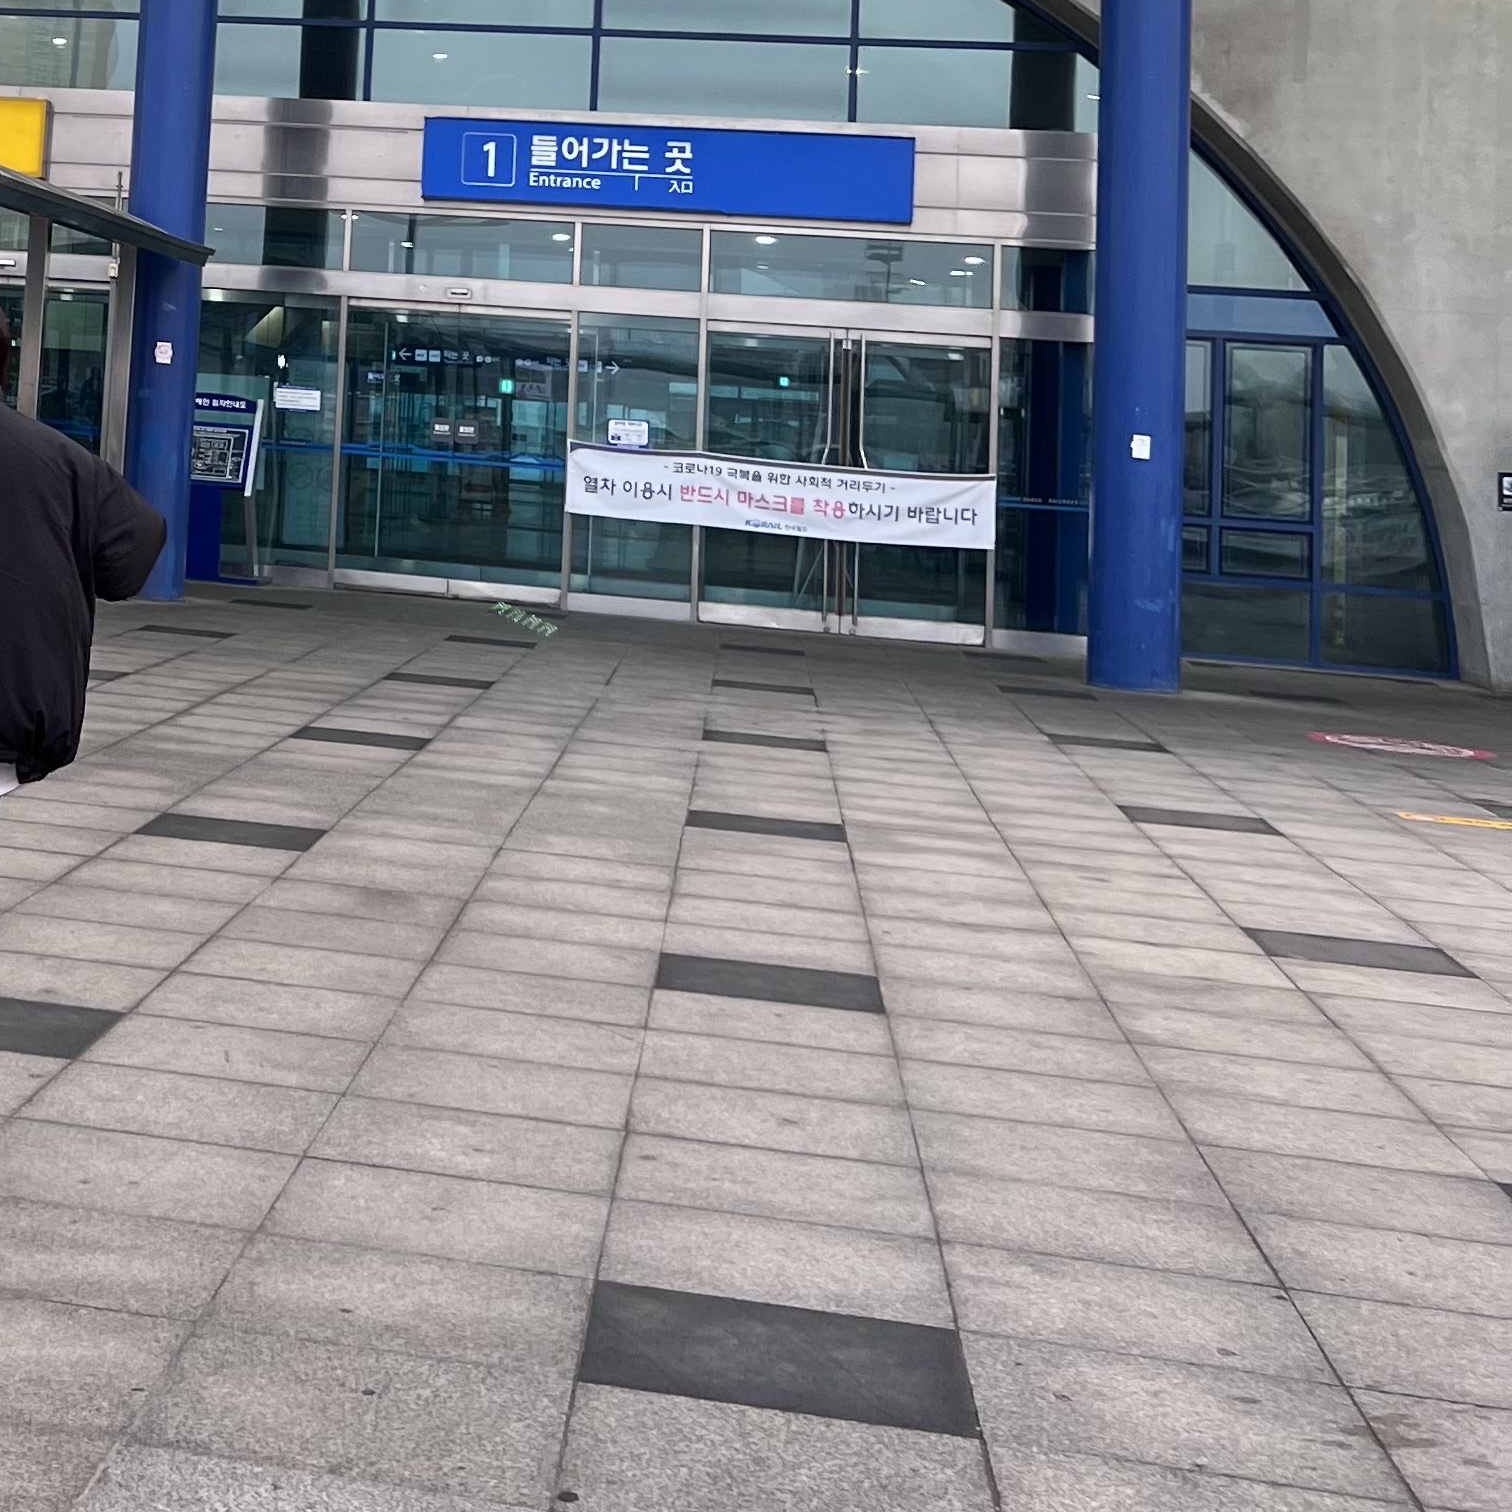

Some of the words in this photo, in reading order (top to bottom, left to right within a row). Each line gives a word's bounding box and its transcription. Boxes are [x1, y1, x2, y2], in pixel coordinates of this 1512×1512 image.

[482, 141, 496, 177] 1
[531, 135, 650, 171] 들어가는
[664, 140, 693, 174] 곳
[529, 172, 601, 190] Entrance
[668, 180, 693, 194] 入口
[672, 462, 723, 476] 코로나19
[727, 468, 763, 483] 극복을
[767, 472, 791, 486] 위한
[795, 475, 833, 489] 사회적
[836, 478, 886, 494] 거리두기
[583, 475, 616, 496] 열차
[623, 480, 672, 501] 이용시
[679, 485, 730, 506] 반드시
[737, 491, 805, 516] 마스크를
[812, 498, 899, 522] 착용하시기
[906, 505, 978, 526] 바랍니다
